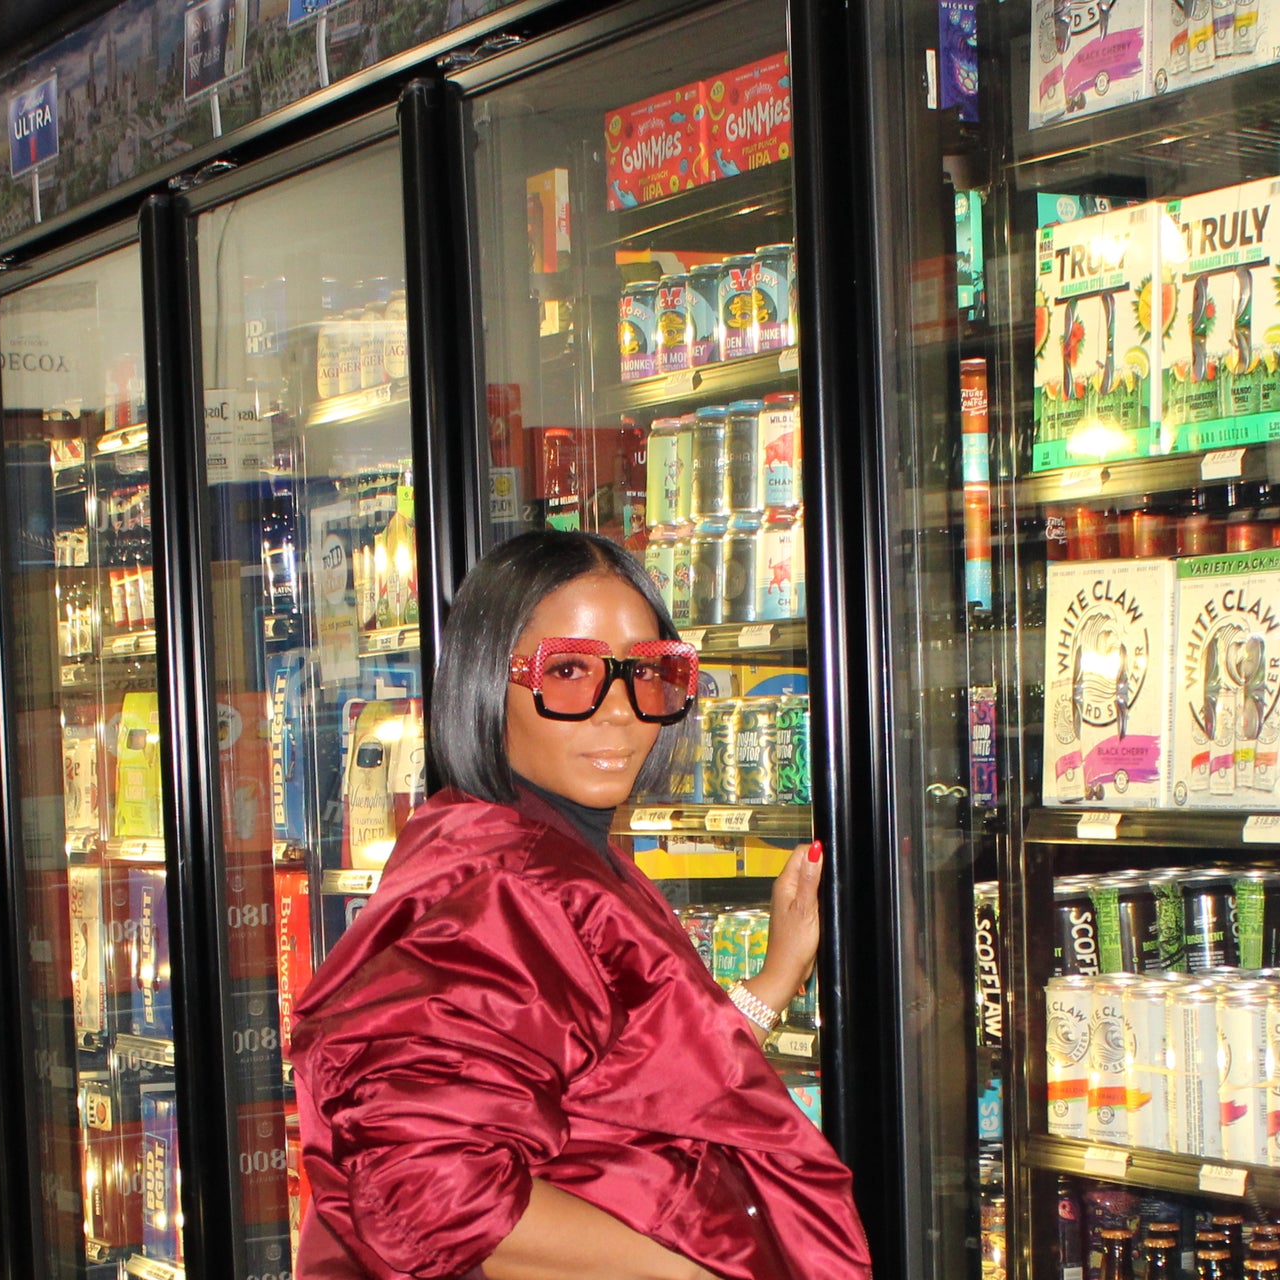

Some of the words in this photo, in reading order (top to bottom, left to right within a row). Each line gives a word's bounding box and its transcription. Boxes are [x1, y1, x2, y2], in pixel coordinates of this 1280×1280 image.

[14, 105, 53, 143] ULTRA
[1190, 559, 1230, 575] VARIETY
[1233, 556, 1265, 571] PACK
[1057, 589, 1087, 675] WHITE
[1092, 580, 1143, 625] CLAW
[1184, 599, 1219, 689] WHITE
[1222, 589, 1280, 633] CLAW
[272, 674, 286, 758] LIGHT
[273, 769, 285, 829] BUD
[351, 824, 386, 847] LAGER
[278, 895, 292, 1046] Budweiser
[975, 918, 1002, 1038] SCOFFLAW
